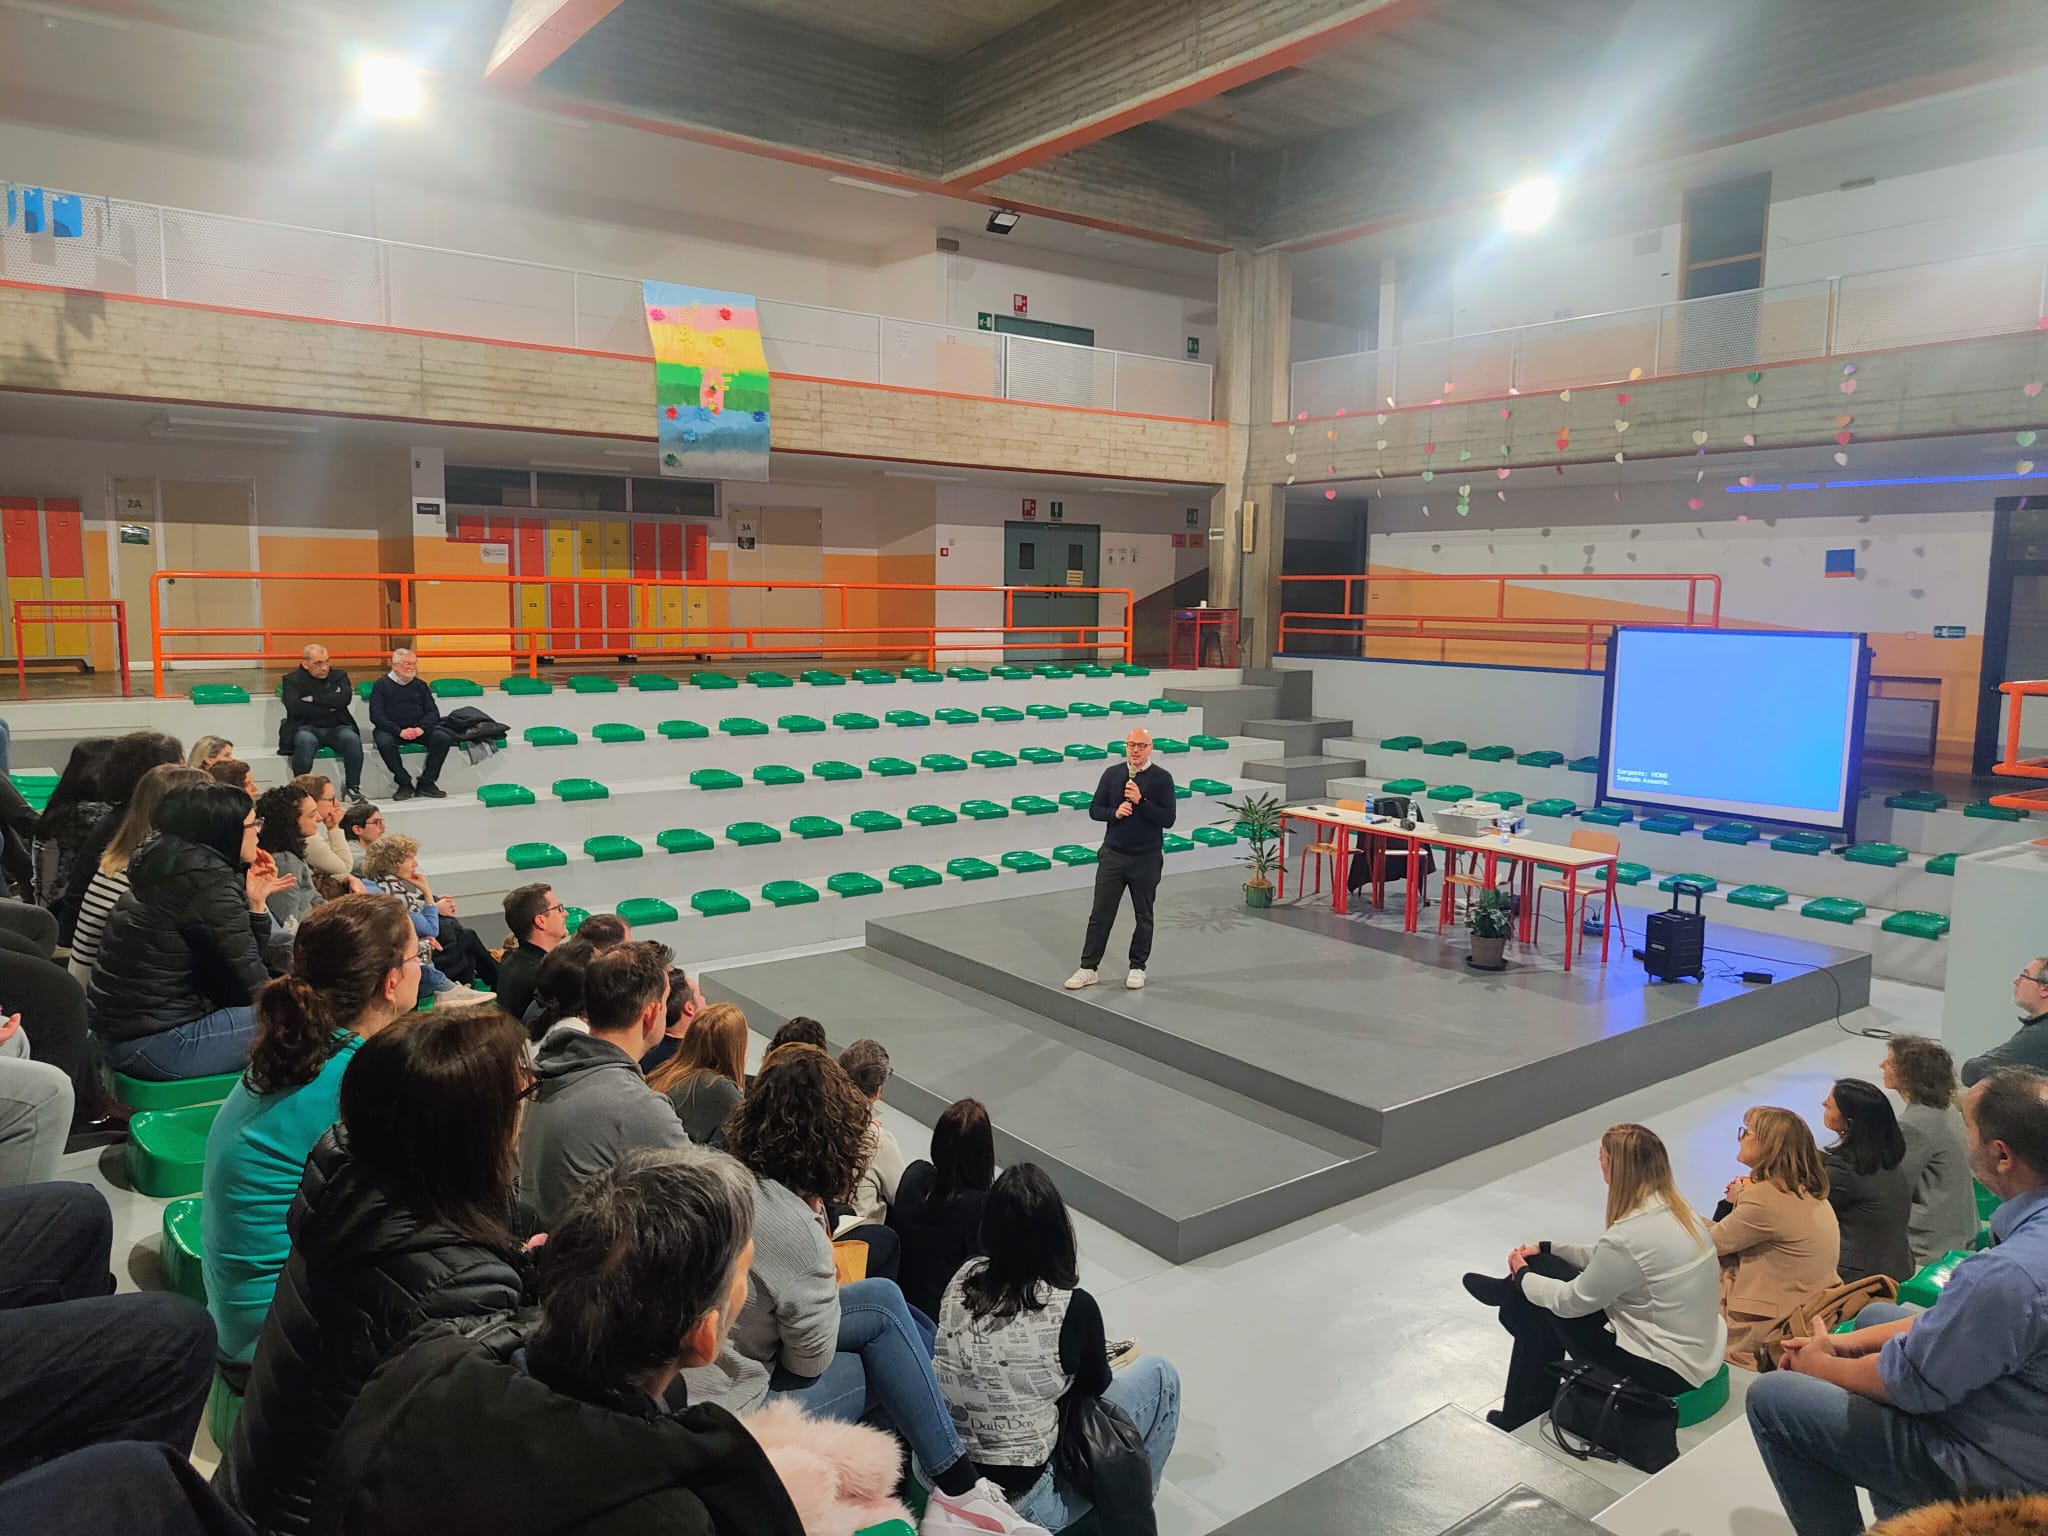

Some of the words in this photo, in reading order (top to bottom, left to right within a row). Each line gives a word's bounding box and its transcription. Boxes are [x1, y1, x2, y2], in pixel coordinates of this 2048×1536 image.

[127, 499, 143, 508] 2A
[741, 523, 752, 531] 3A
[970, 1418, 1005, 1433] Daily
[1007, 1419, 1036, 1431] Day
